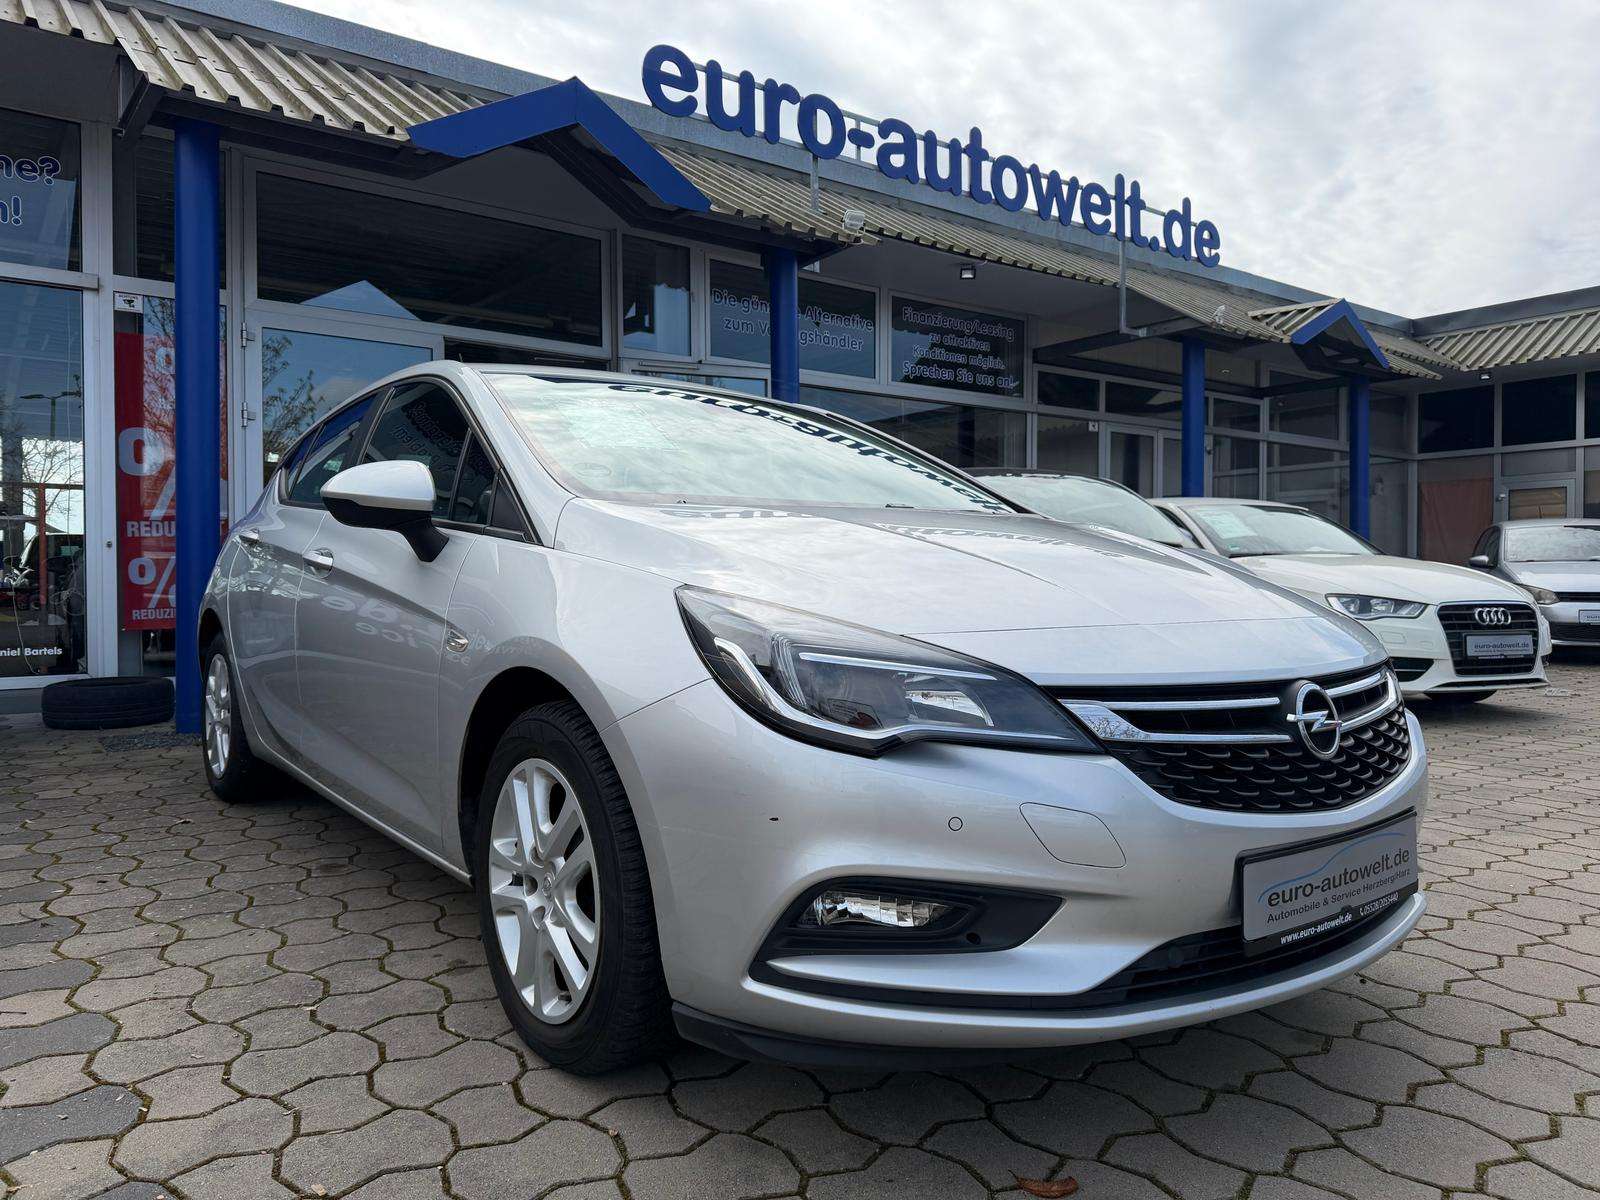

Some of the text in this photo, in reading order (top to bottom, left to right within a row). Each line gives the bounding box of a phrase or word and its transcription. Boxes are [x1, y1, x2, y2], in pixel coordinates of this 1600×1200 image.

[642, 44, 1221, 268] euro-autowelt.de
[711, 288, 737, 307] Die
[805, 306, 874, 331] Alternative
[902, 305, 1015, 342] Finanzierung/Leasing
[723, 317, 754, 335] zum
[912, 344, 968, 364] Konditionen
[929, 333, 990, 352] zu attraktiven
[902, 360, 1014, 389] Sprechen Sie uns an!
[126, 520, 176, 537] REDU
[132, 608, 176, 620] REDUZI
[24, 646, 63, 656] Bartels
[1267, 848, 1410, 907] euro-autowelt.de
[1266, 899, 1321, 923] Automobile
[1322, 897, 1329, 907] &
[1331, 888, 1361, 904] Service
[1280, 912, 1353, 944] www.euro-autowelt.de
